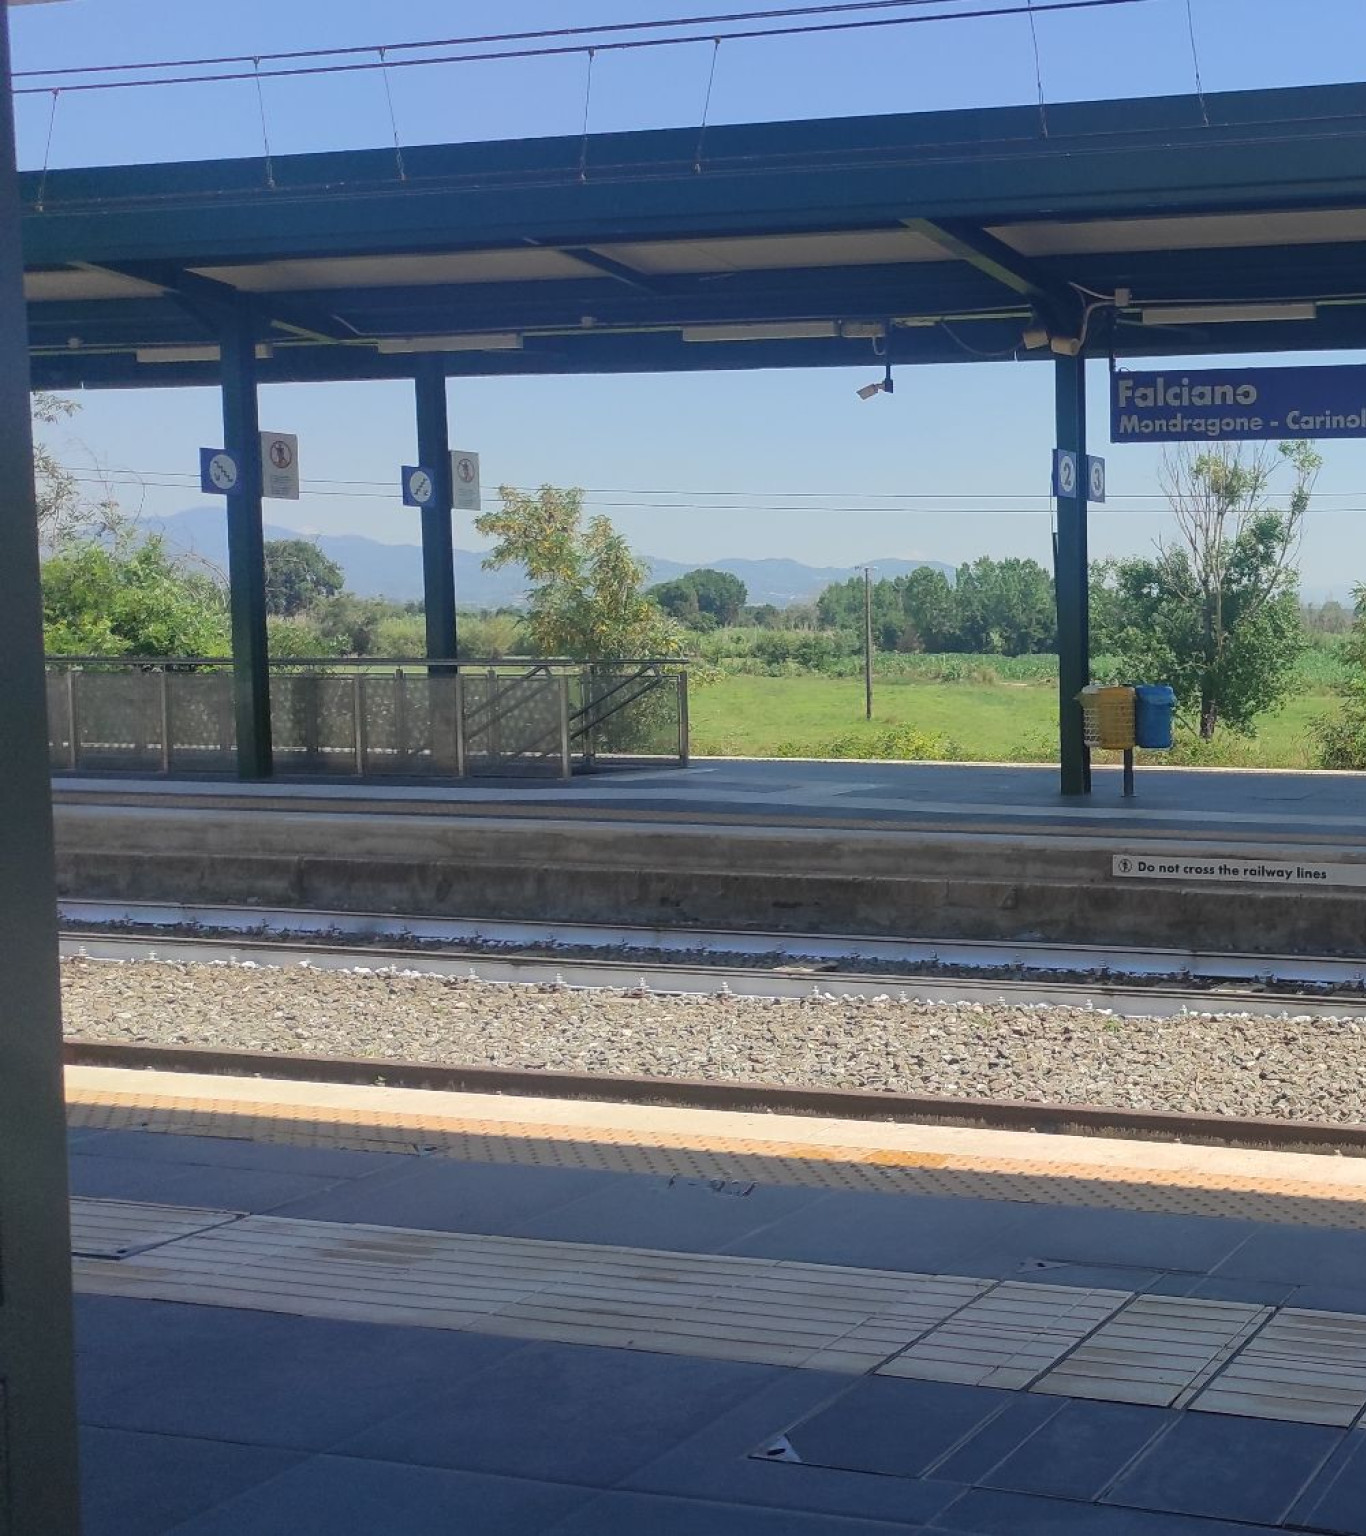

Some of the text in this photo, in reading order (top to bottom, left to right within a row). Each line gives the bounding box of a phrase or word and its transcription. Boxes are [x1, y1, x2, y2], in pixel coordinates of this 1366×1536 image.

[1118, 378, 1257, 408] Falciano
[1119, 413, 1263, 436] Mondragone
[1063, 462, 1071, 486] 2
[1094, 467, 1101, 491] 3
[1138, 862, 1327, 879] Do not cross the railway lines
